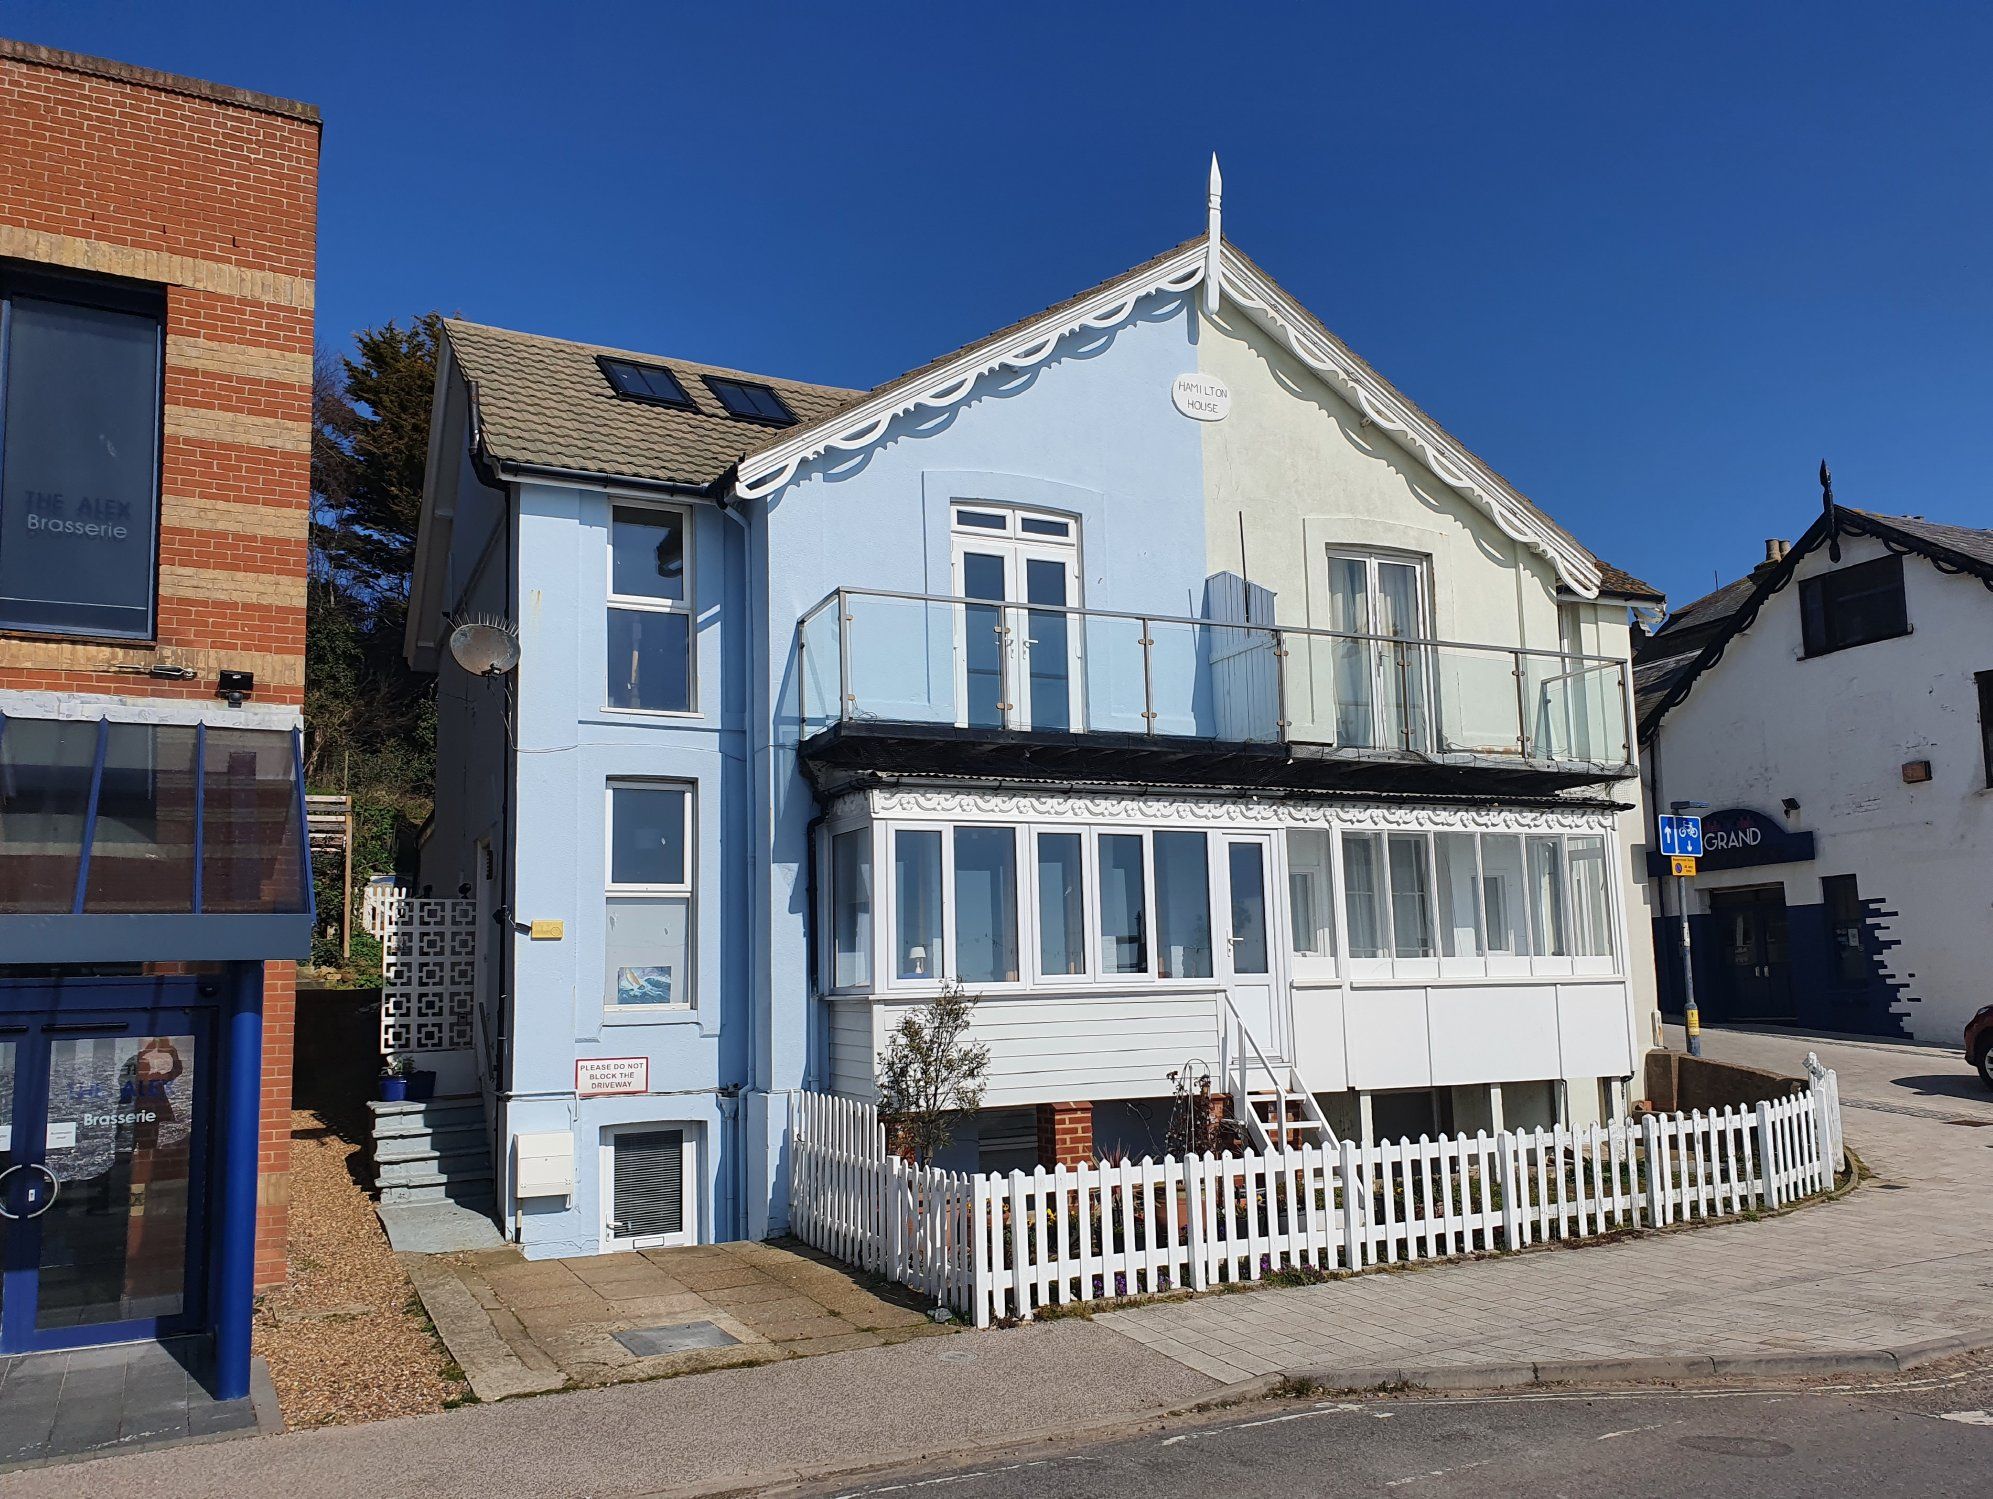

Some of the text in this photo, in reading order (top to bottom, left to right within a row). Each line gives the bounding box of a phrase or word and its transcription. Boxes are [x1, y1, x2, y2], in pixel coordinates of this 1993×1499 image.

[1178, 380, 1228, 399] HAMILTON
[1187, 398, 1219, 414] HOUSE
[25, 490, 131, 520] THE ALEX
[27, 513, 128, 539] Brasserie
[1703, 827, 1762, 851] GRAND
[580, 1063, 612, 1072] PLEASE
[627, 1062, 644, 1070] NOT
[591, 1081, 633, 1089] DRIVEWAY
[83, 1110, 157, 1126] Brasserie
